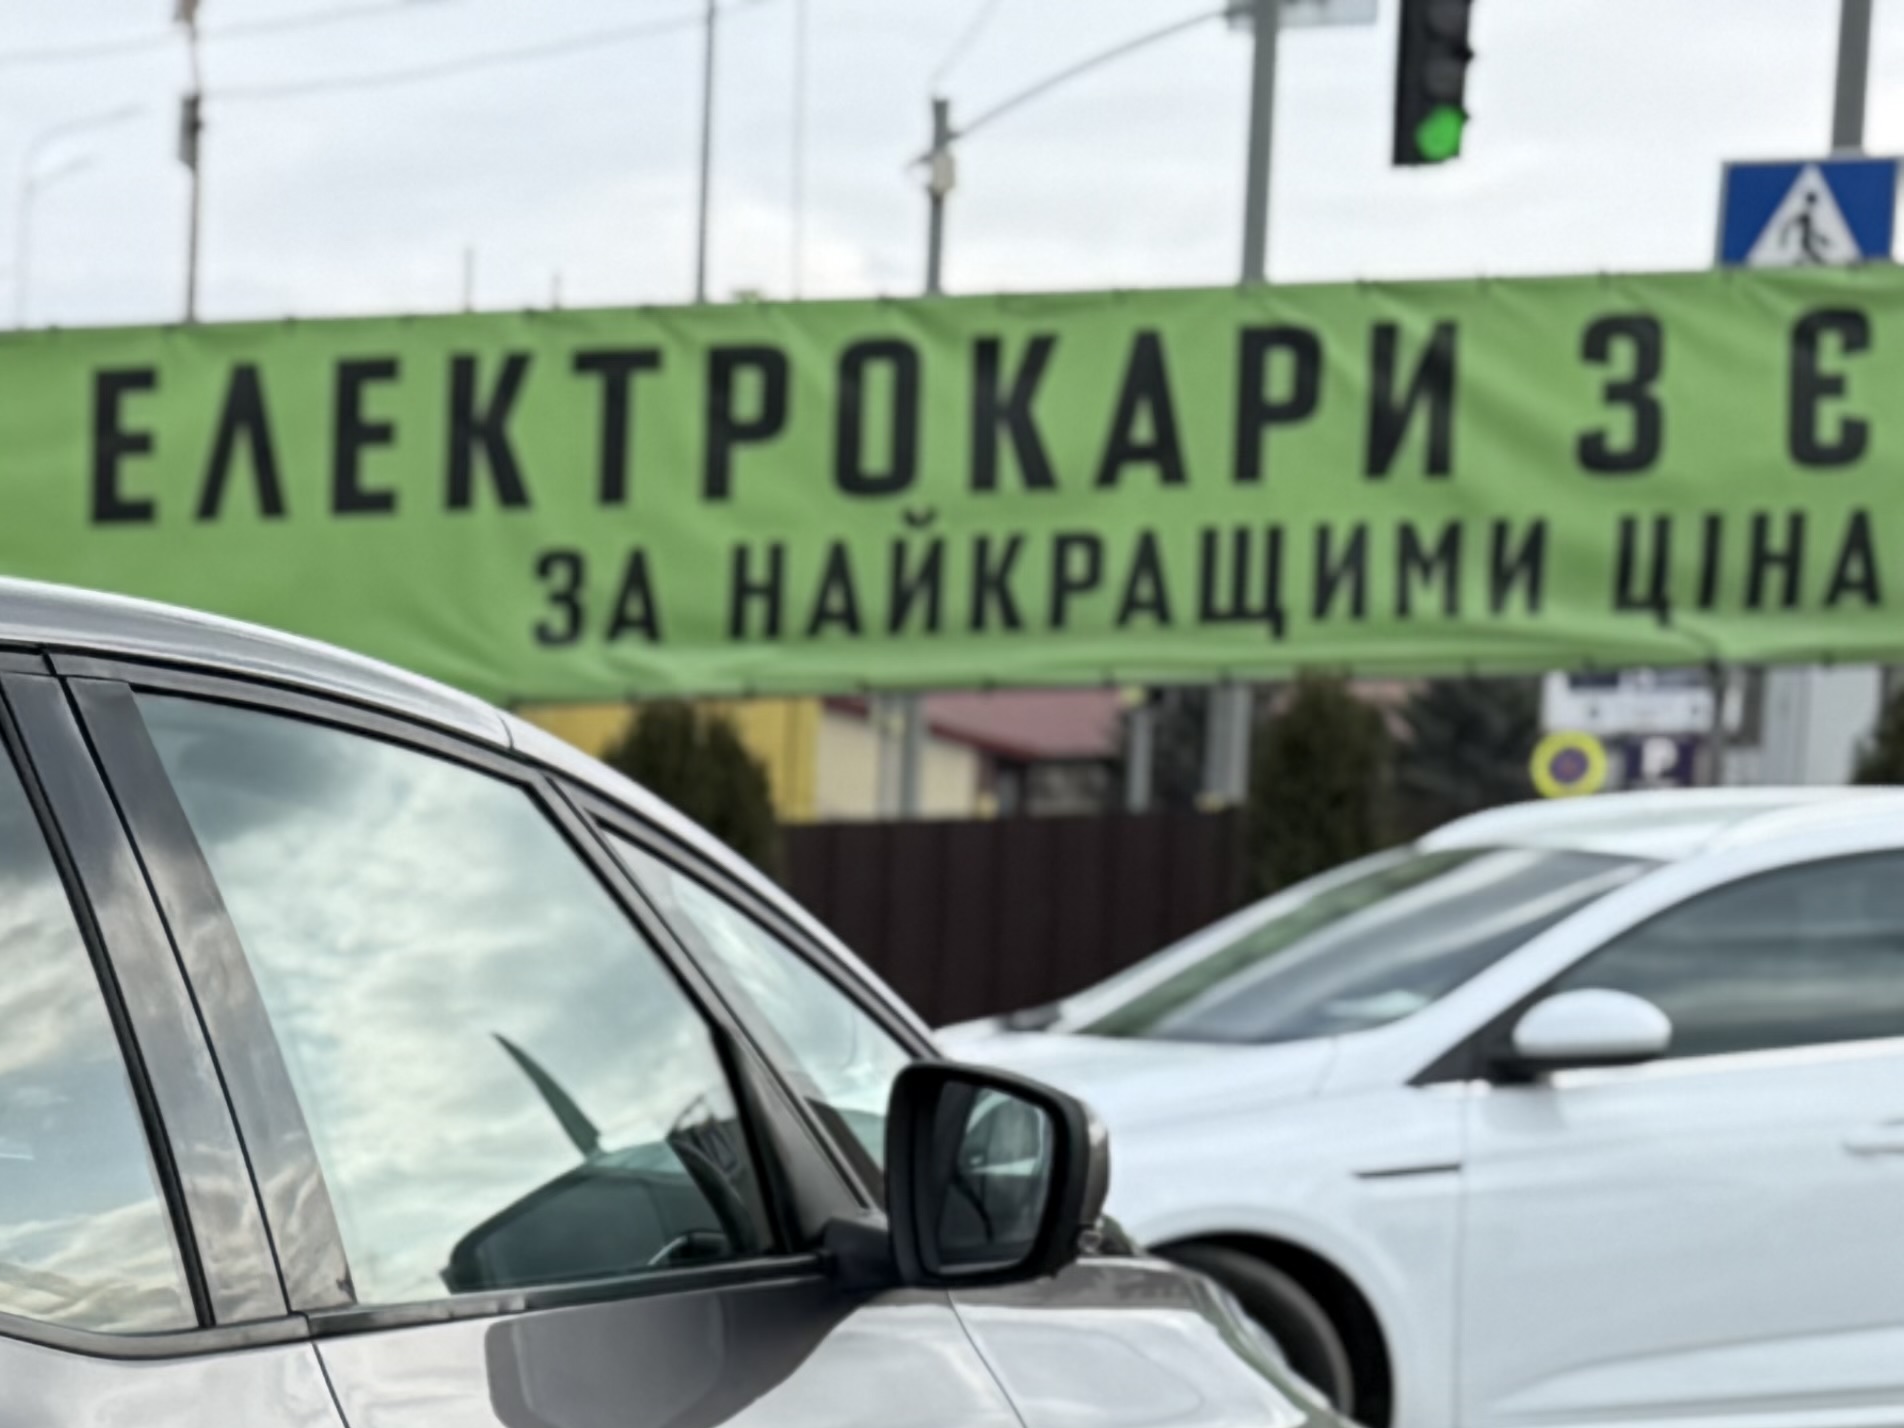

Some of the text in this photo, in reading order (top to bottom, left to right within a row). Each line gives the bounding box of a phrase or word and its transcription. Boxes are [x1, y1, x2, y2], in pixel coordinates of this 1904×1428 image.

[87, 302, 1873, 527] ЕЛЕКТРОКАРИ З Є
[533, 507, 1885, 643] ЗА НАЙКРАЩИМИ ЦІНА
